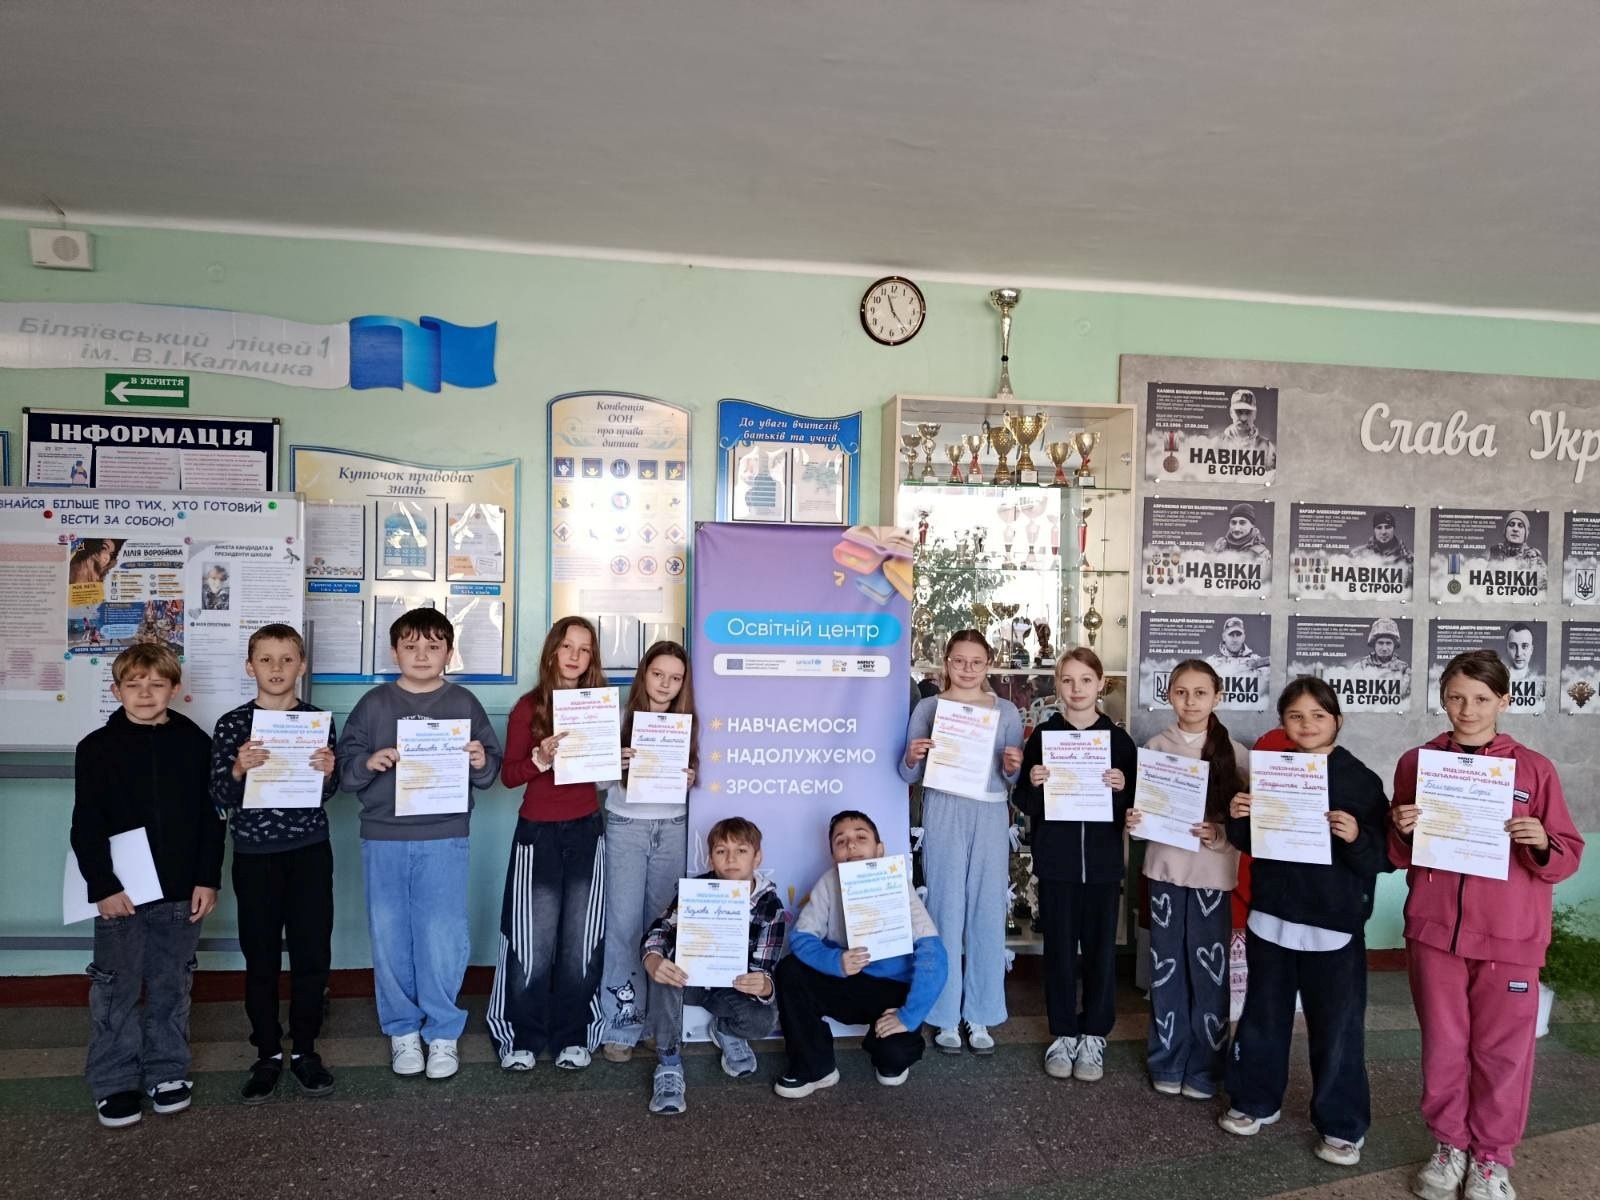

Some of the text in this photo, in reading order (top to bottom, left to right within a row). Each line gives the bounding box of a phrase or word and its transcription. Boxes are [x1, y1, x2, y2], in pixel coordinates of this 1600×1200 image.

[18, 316, 209, 348] Біляївський
[227, 334, 311, 357] ліцей
[80, 343, 314, 377] ім. В.І.Калмика
[140, 377, 185, 386] УКРИТТЯ
[596, 401, 645, 412] Конвенція
[607, 414, 633, 423] ООН
[739, 417, 841, 431] До уваги вчителів,
[50, 423, 253, 448] ІНФОРМАЦІЯ
[597, 426, 644, 437] про права
[743, 430, 786, 440] батьків
[810, 433, 837, 443] учнів
[1360, 402, 1600, 484] Слава Укр
[1189, 447, 1266, 466] НАВІКИ
[339, 466, 475, 485] Куточок правових
[1208, 464, 1267, 476] В СТРОЮ
[386, 484, 426, 496] знань
[53, 498, 99, 510] БІЛЬШЕ
[105, 499, 130, 510] ПРО
[136, 500, 167, 513] ТИХ,
[172, 500, 198, 511] ХТО
[203, 500, 262, 513] ГОТОВИЙ
[60, 514, 175, 528] ВЕСТИ ЗА СОБОЮ!
[122, 547, 183, 557] ЛІЛІЯ ВОРОБЙОВА
[1185, 561, 1261, 579] НАВІКИ
[1331, 566, 1403, 583] НАВІКИ
[1204, 578, 1261, 590] В СТРОЮ
[1469, 570, 1538, 586] НАВІКИ
[1349, 583, 1403, 594] В СТРОЮ
[1486, 586, 1538, 597] В СТРОЮ
[727, 617, 880, 642] Освітній центр
[1329, 679, 1400, 695] НАВІКИ
[1221, 692, 1259, 703] ТРОЮ
[1346, 695, 1401, 706] В СТРОЮ
[727, 717, 857, 734] НАВЧАЄМОСЯ
[727, 748, 876, 766] НАДОЛУЖУЄМО
[726, 778, 843, 795] ЗРОСТАЄМО
